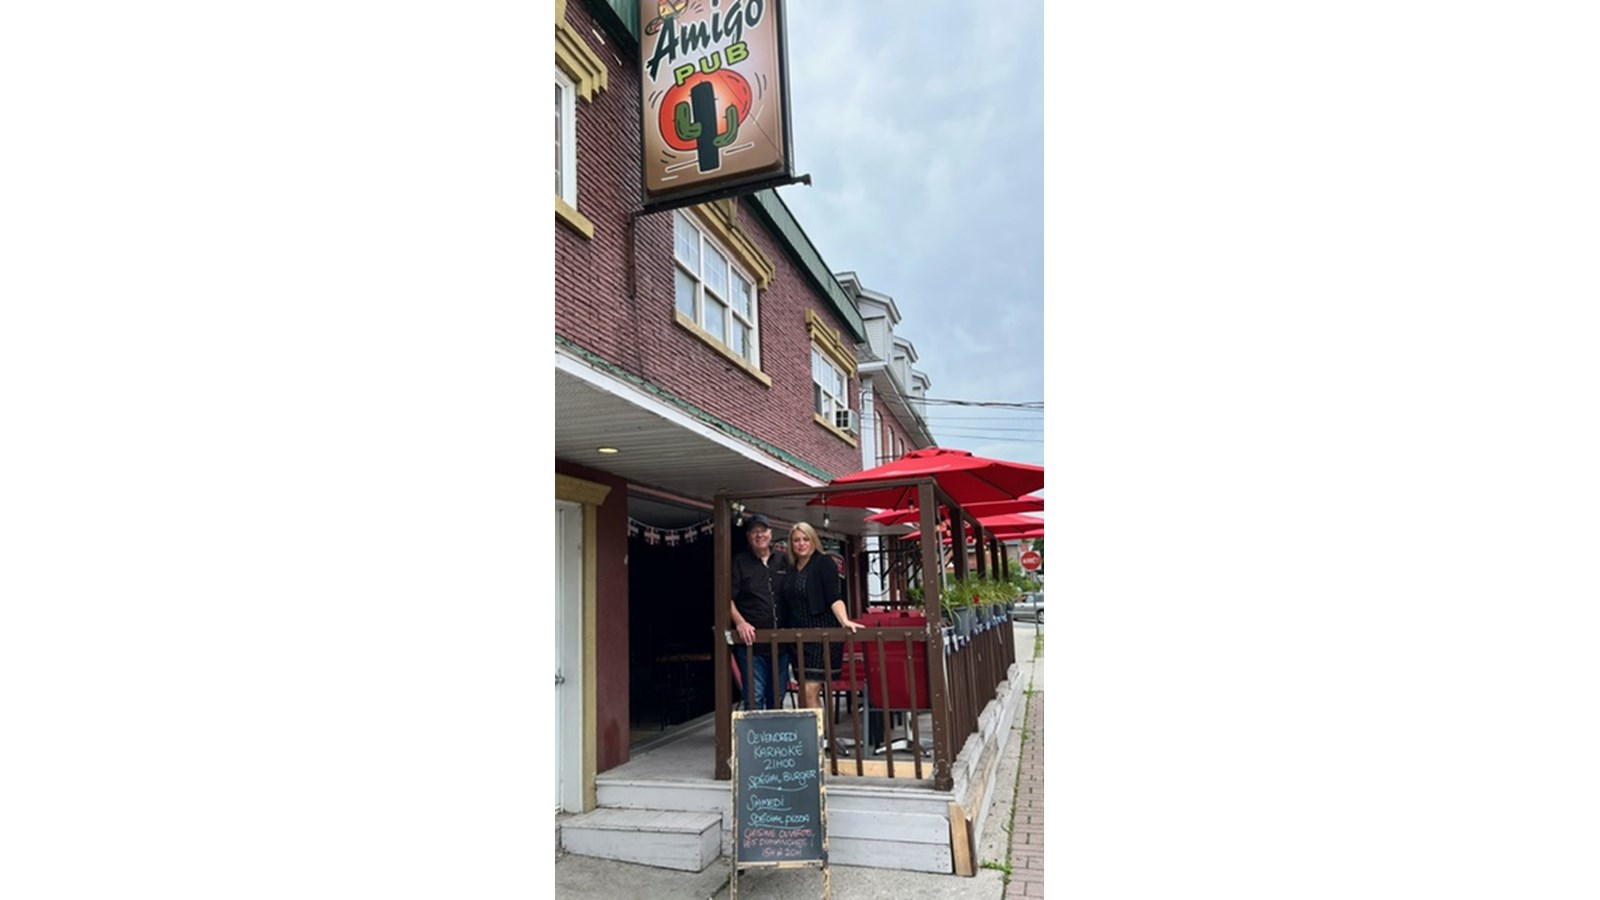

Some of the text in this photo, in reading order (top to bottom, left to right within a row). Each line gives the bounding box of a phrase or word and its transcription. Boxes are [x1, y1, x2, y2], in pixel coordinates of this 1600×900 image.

[646, 0, 763, 82] Amigo
[674, 42, 749, 86] PUB
[754, 741, 803, 759] KARAOKÉ
[764, 759, 795, 770] 21H00
[783, 770, 816, 786] BURGER
[747, 794, 784, 811] SAMEDI
